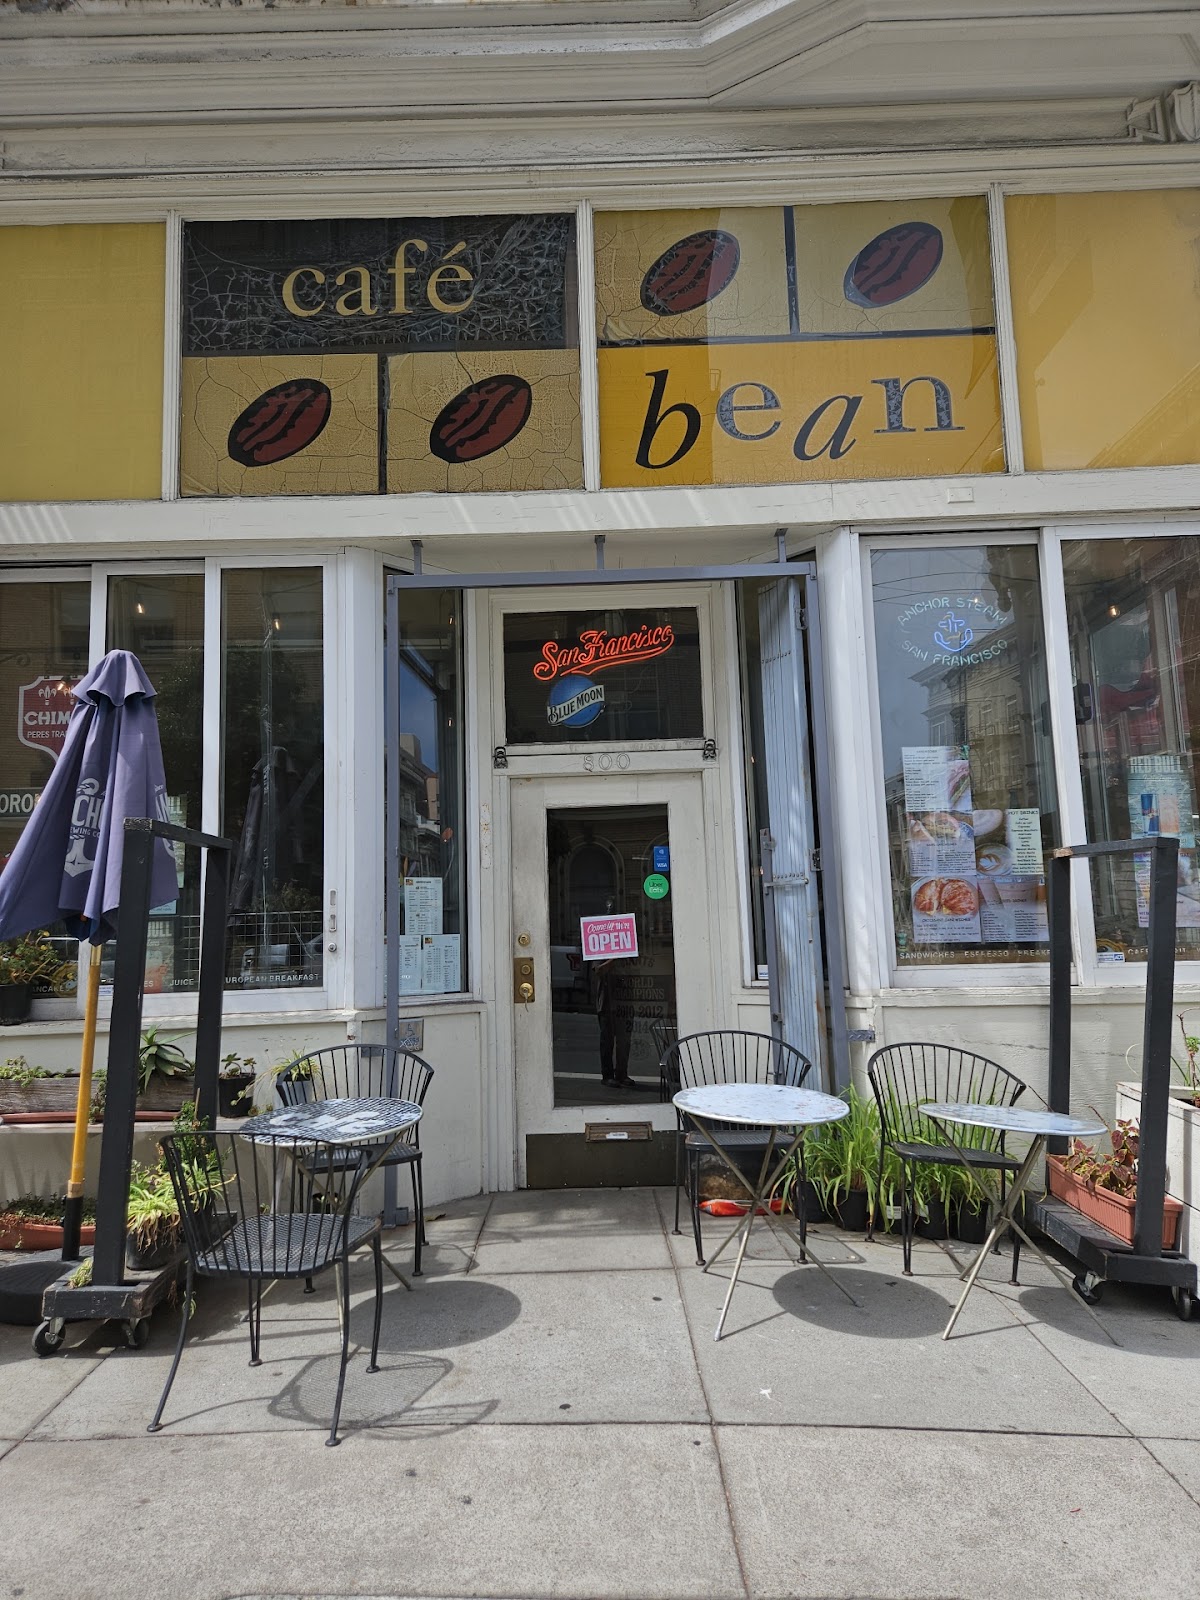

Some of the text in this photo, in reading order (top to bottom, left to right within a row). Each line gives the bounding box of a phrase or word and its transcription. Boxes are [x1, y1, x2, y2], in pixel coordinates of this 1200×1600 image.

[281, 238, 475, 318] café
[634, 368, 966, 470] bean
[897, 597, 1007, 626] ANCHOR STEAM
[533, 624, 675, 681] San Francisco
[902, 639, 1008, 666] SAN FRANCISCO
[547, 686, 603, 725] BLUE MOON
[23, 711, 71, 726] CHIM
[27, 730, 66, 739] PERES TRA
[583, 753, 631, 772] 800
[0, 793, 40, 814] ORO
[588, 931, 632, 952] OPEN
[900, 950, 955, 960] SANDWICHES
[169, 978, 194, 986] JUICE
[225, 973, 319, 984] UROPEAN BREAKFAST
